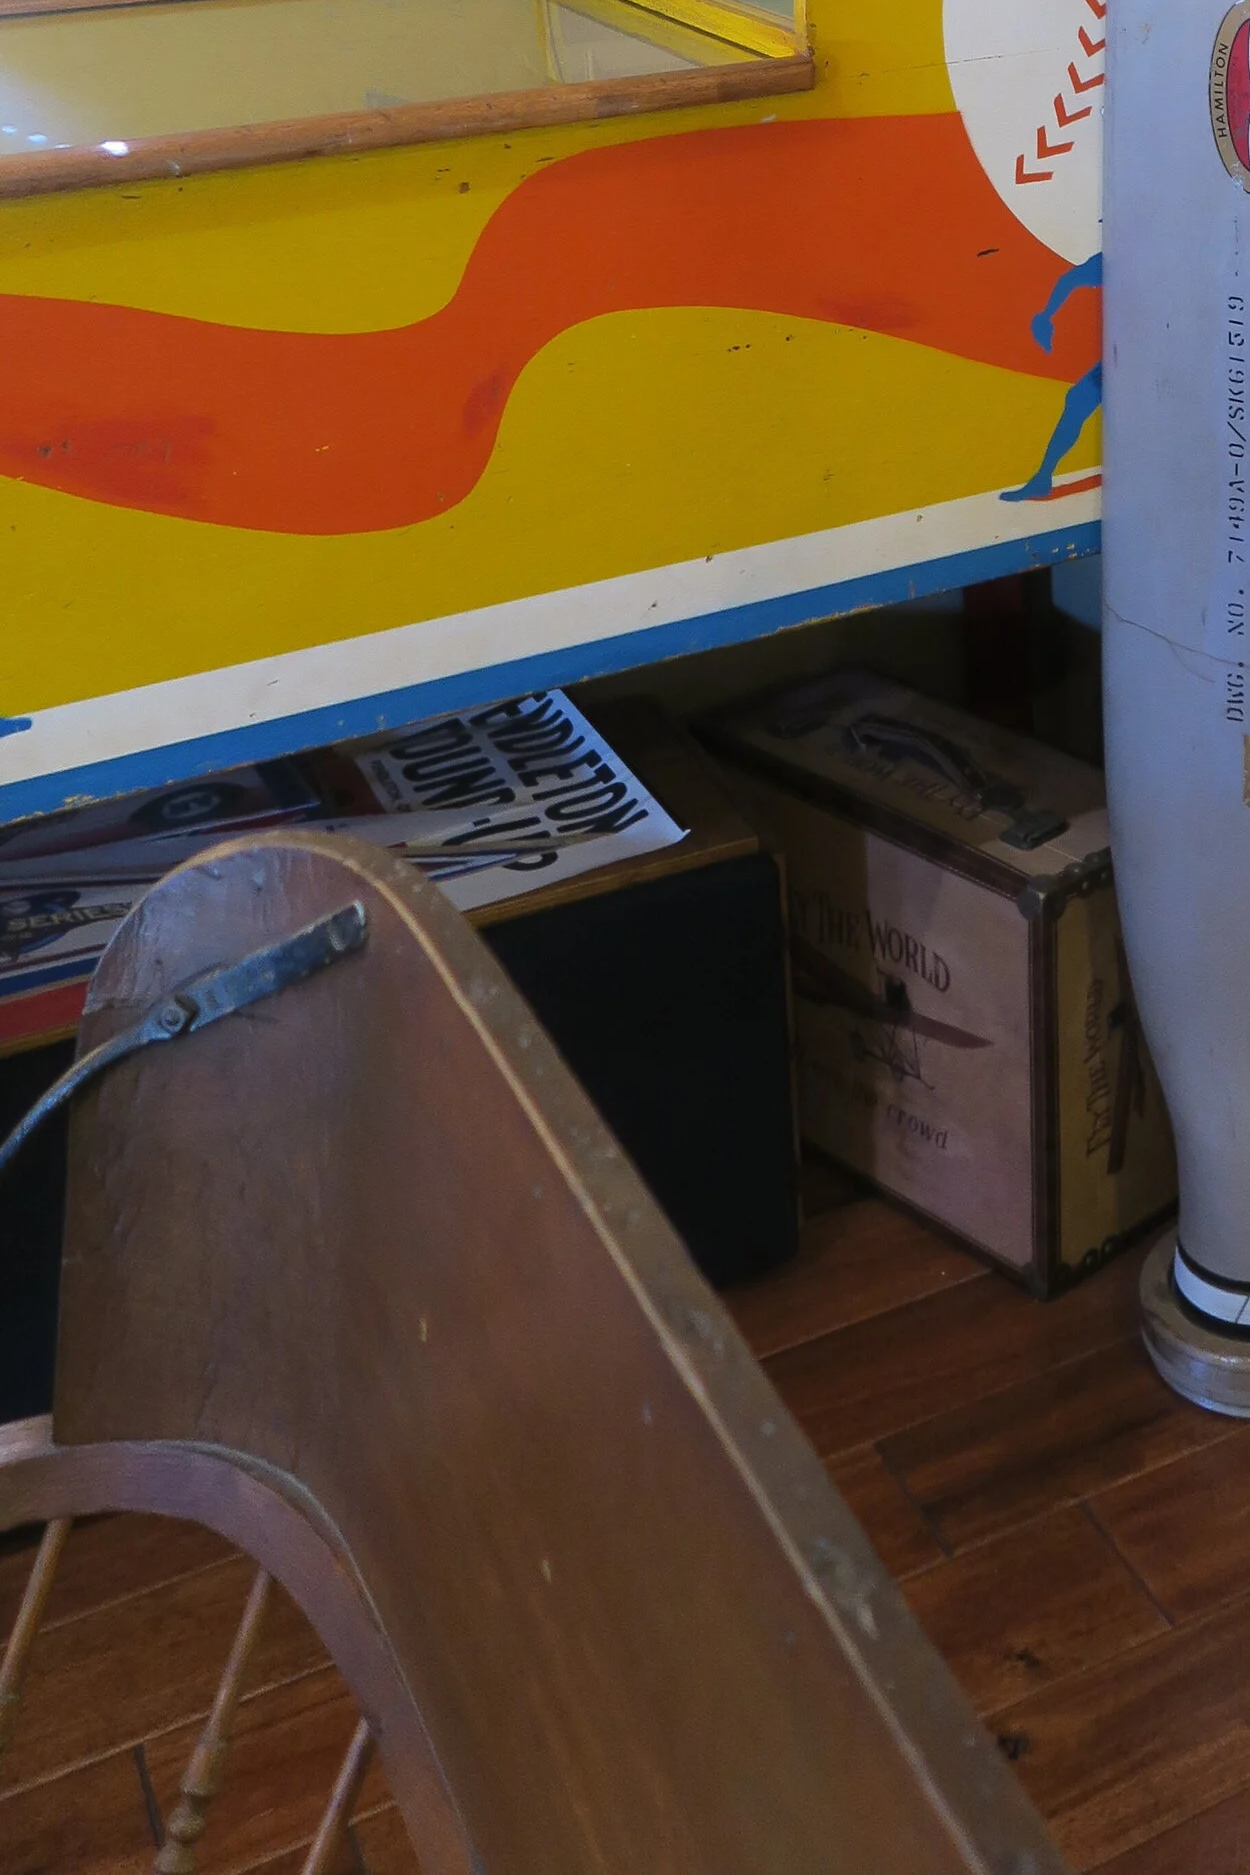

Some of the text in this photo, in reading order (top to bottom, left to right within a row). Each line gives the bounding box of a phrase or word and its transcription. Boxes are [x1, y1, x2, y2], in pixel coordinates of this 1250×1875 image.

[1213, 43, 1229, 138] HAMILTON
[1228, 589, 1245, 635] NO.
[864, 909, 950, 993] WORLD
[887, 1104, 948, 1150] crowd
